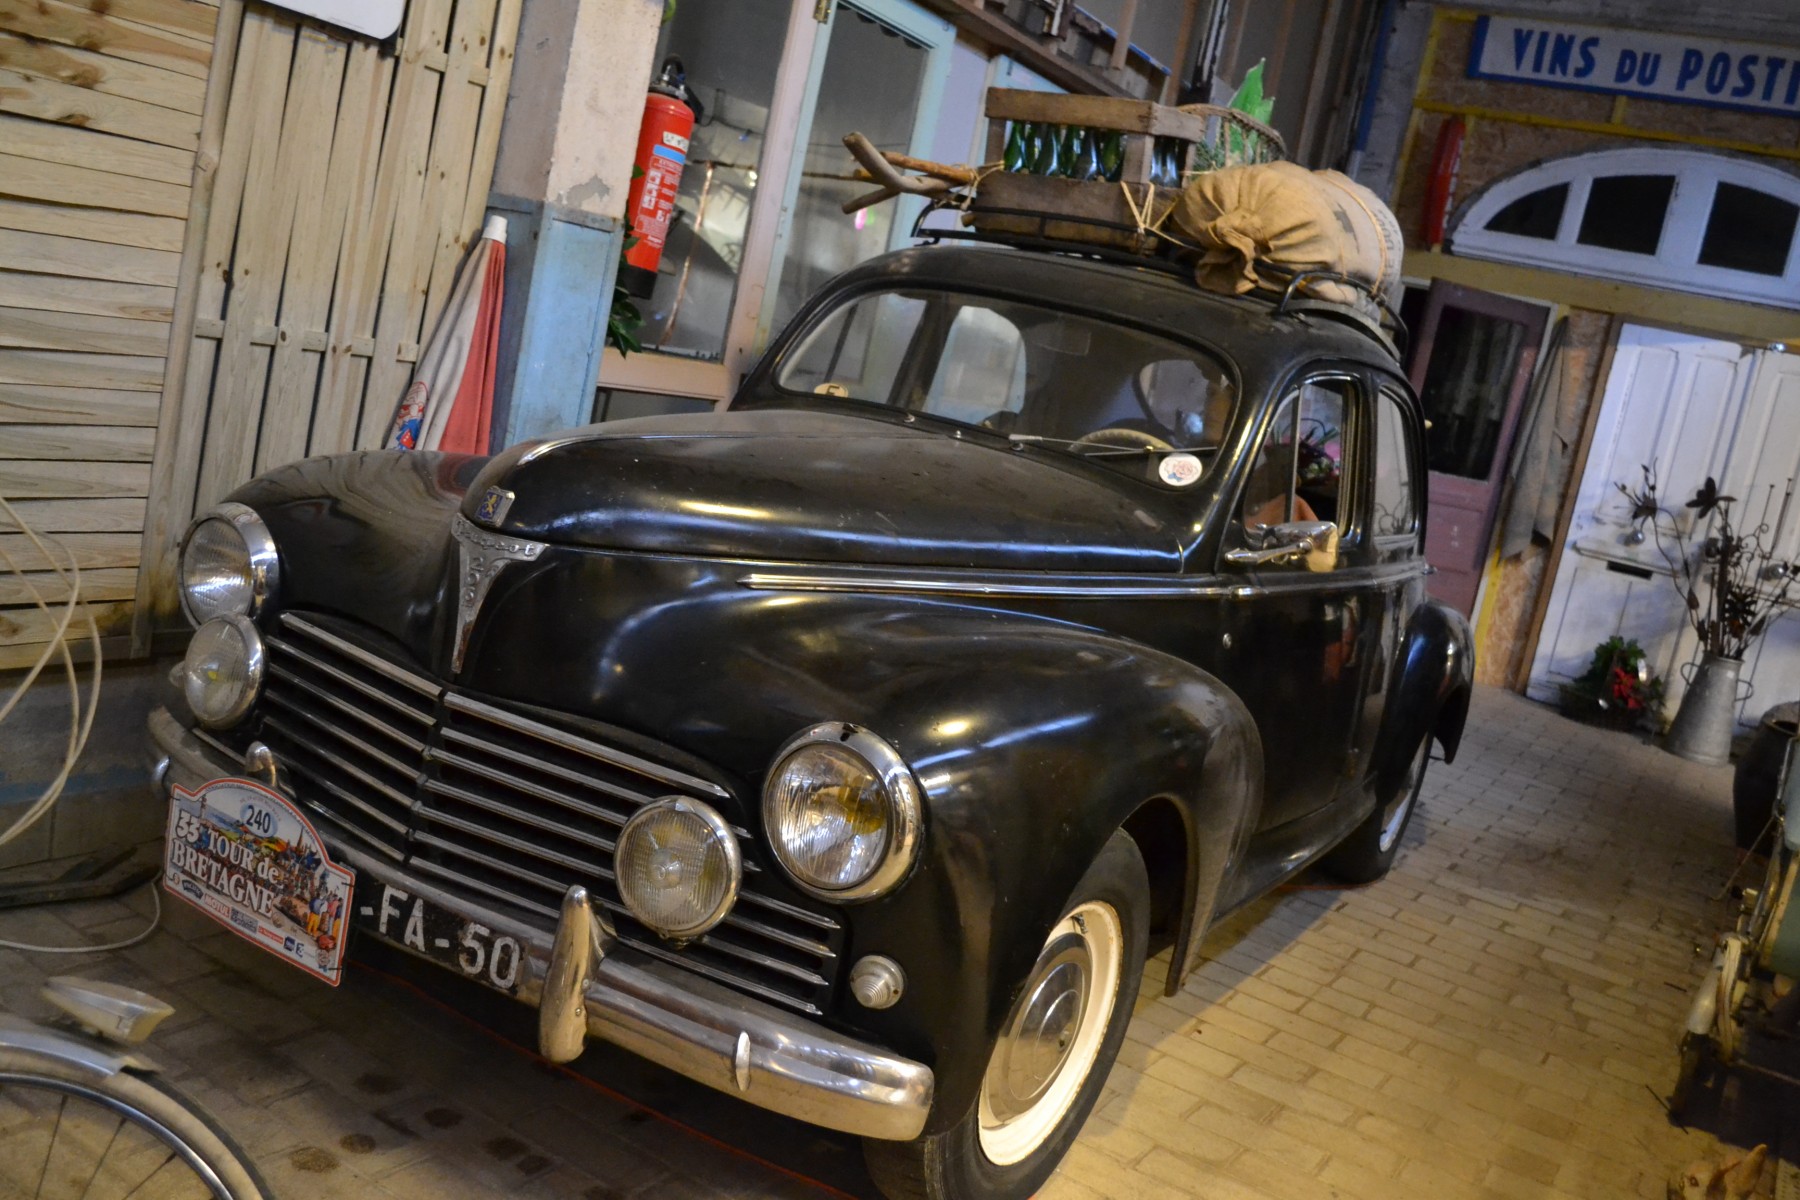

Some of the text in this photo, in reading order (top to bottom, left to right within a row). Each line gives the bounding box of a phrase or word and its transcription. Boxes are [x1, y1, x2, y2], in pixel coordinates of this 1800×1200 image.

[1513, 28, 1599, 78] VINS
[1614, 49, 1661, 86] DU
[176, 809, 279, 884] 33 TOUR de
[246, 804, 271, 834] 240
[172, 839, 275, 919] BRETAGNE
